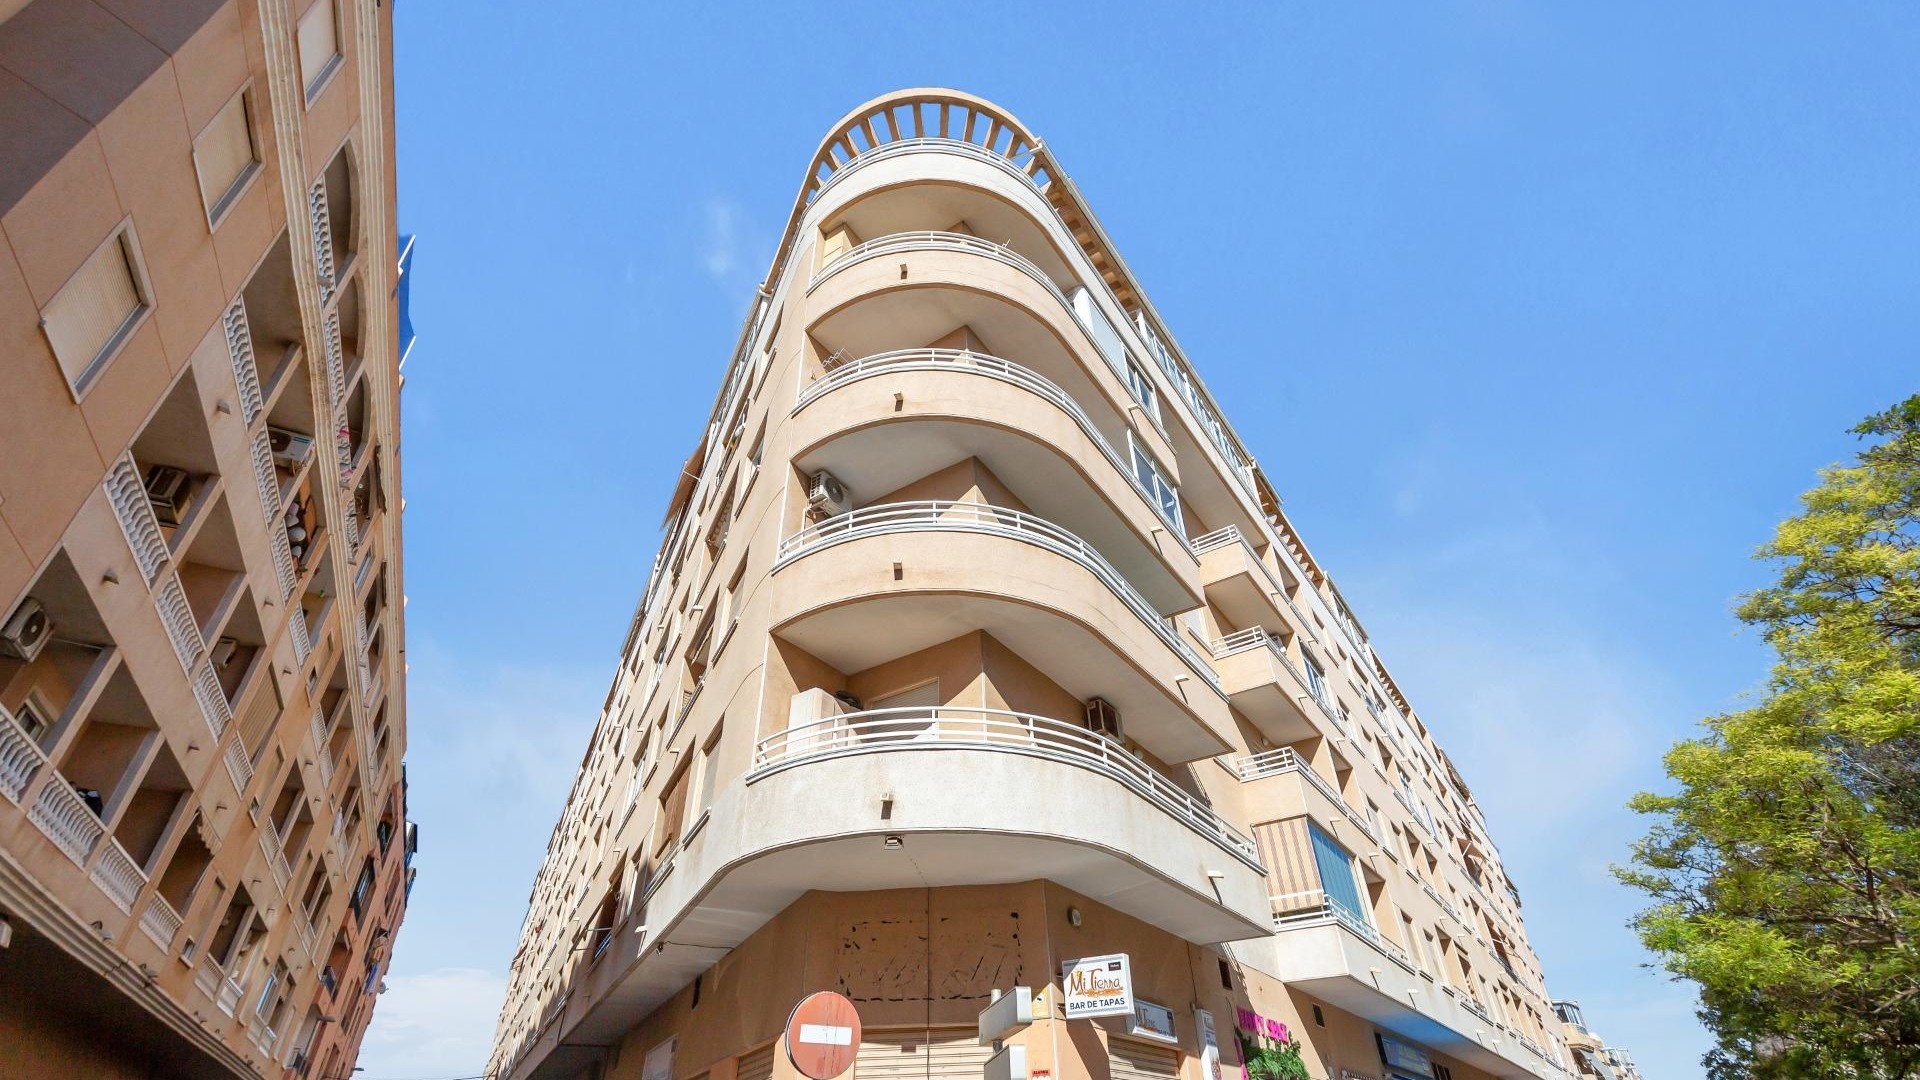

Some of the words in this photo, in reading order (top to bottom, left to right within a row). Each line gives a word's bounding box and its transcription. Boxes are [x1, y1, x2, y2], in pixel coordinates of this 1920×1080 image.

[1069, 970, 1086, 997] Mi
[1086, 968, 1122, 991] Tierra
[1069, 1001, 1086, 1010] BAR
[1087, 1000, 1098, 1009] DE
[1099, 997, 1126, 1007] TAPAS
